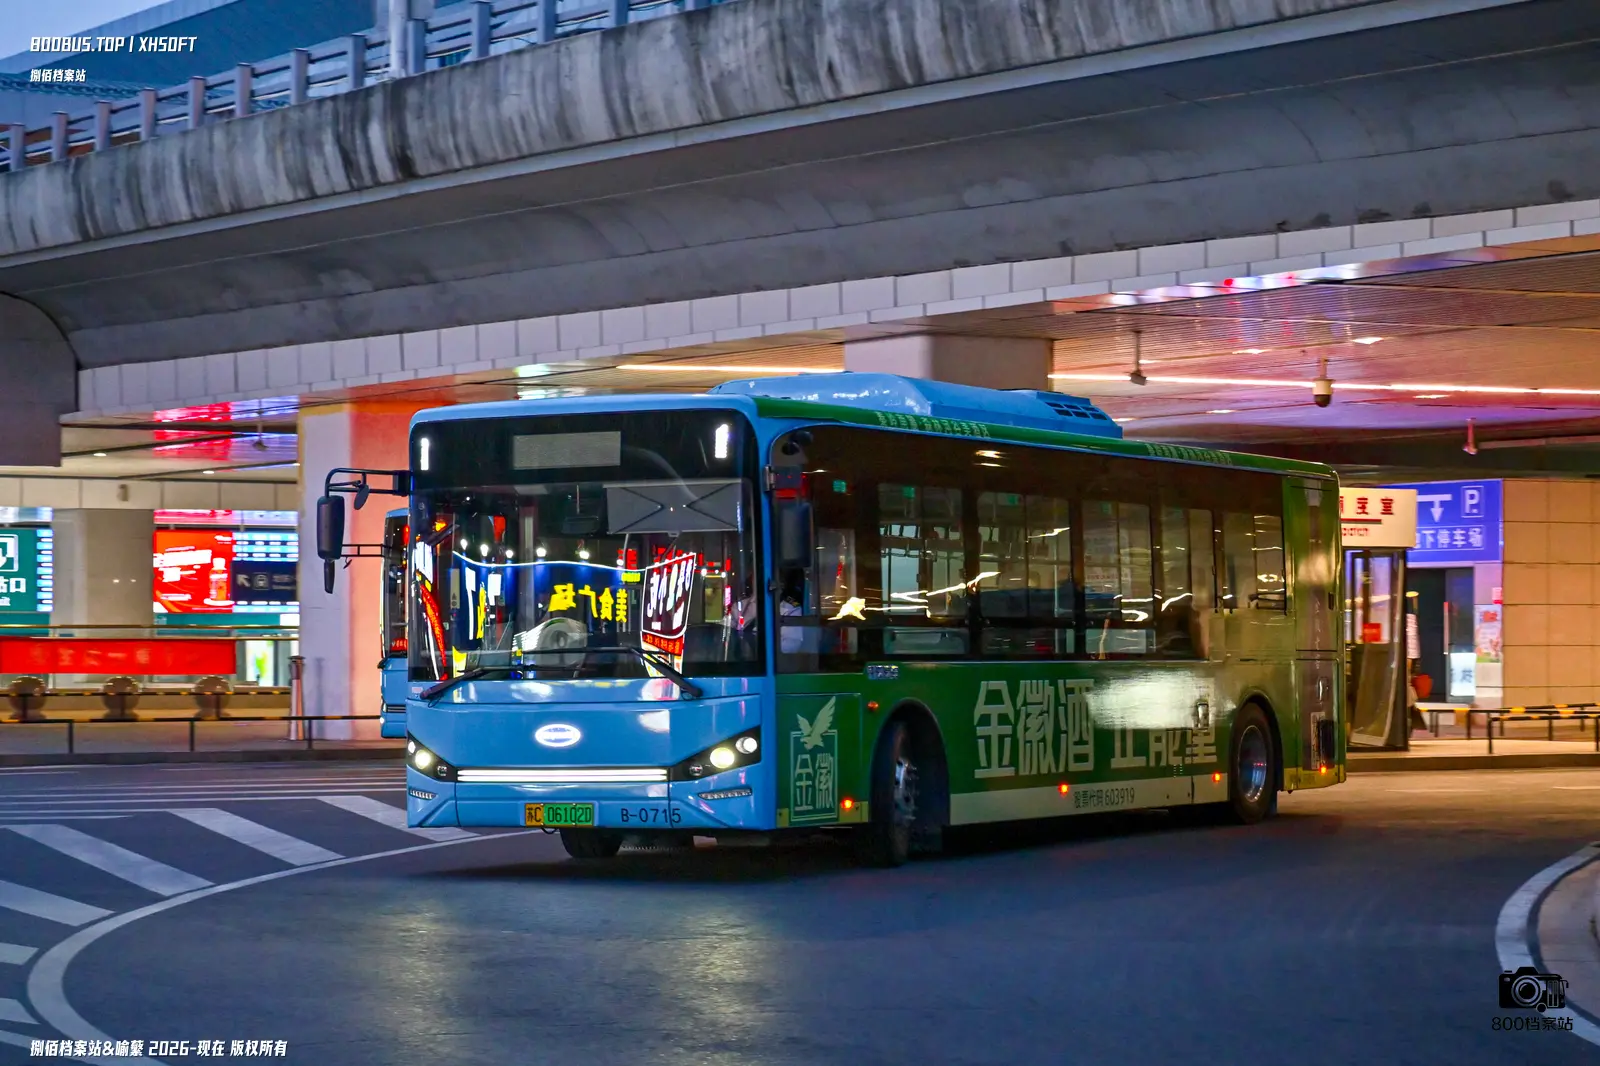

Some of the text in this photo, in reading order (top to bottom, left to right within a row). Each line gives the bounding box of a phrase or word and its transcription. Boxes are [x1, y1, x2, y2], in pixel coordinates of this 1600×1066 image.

[974, 678, 1095, 779] 金徽酒
[795, 752, 835, 812] 金徽
[620, 807, 682, 824] B-0715
